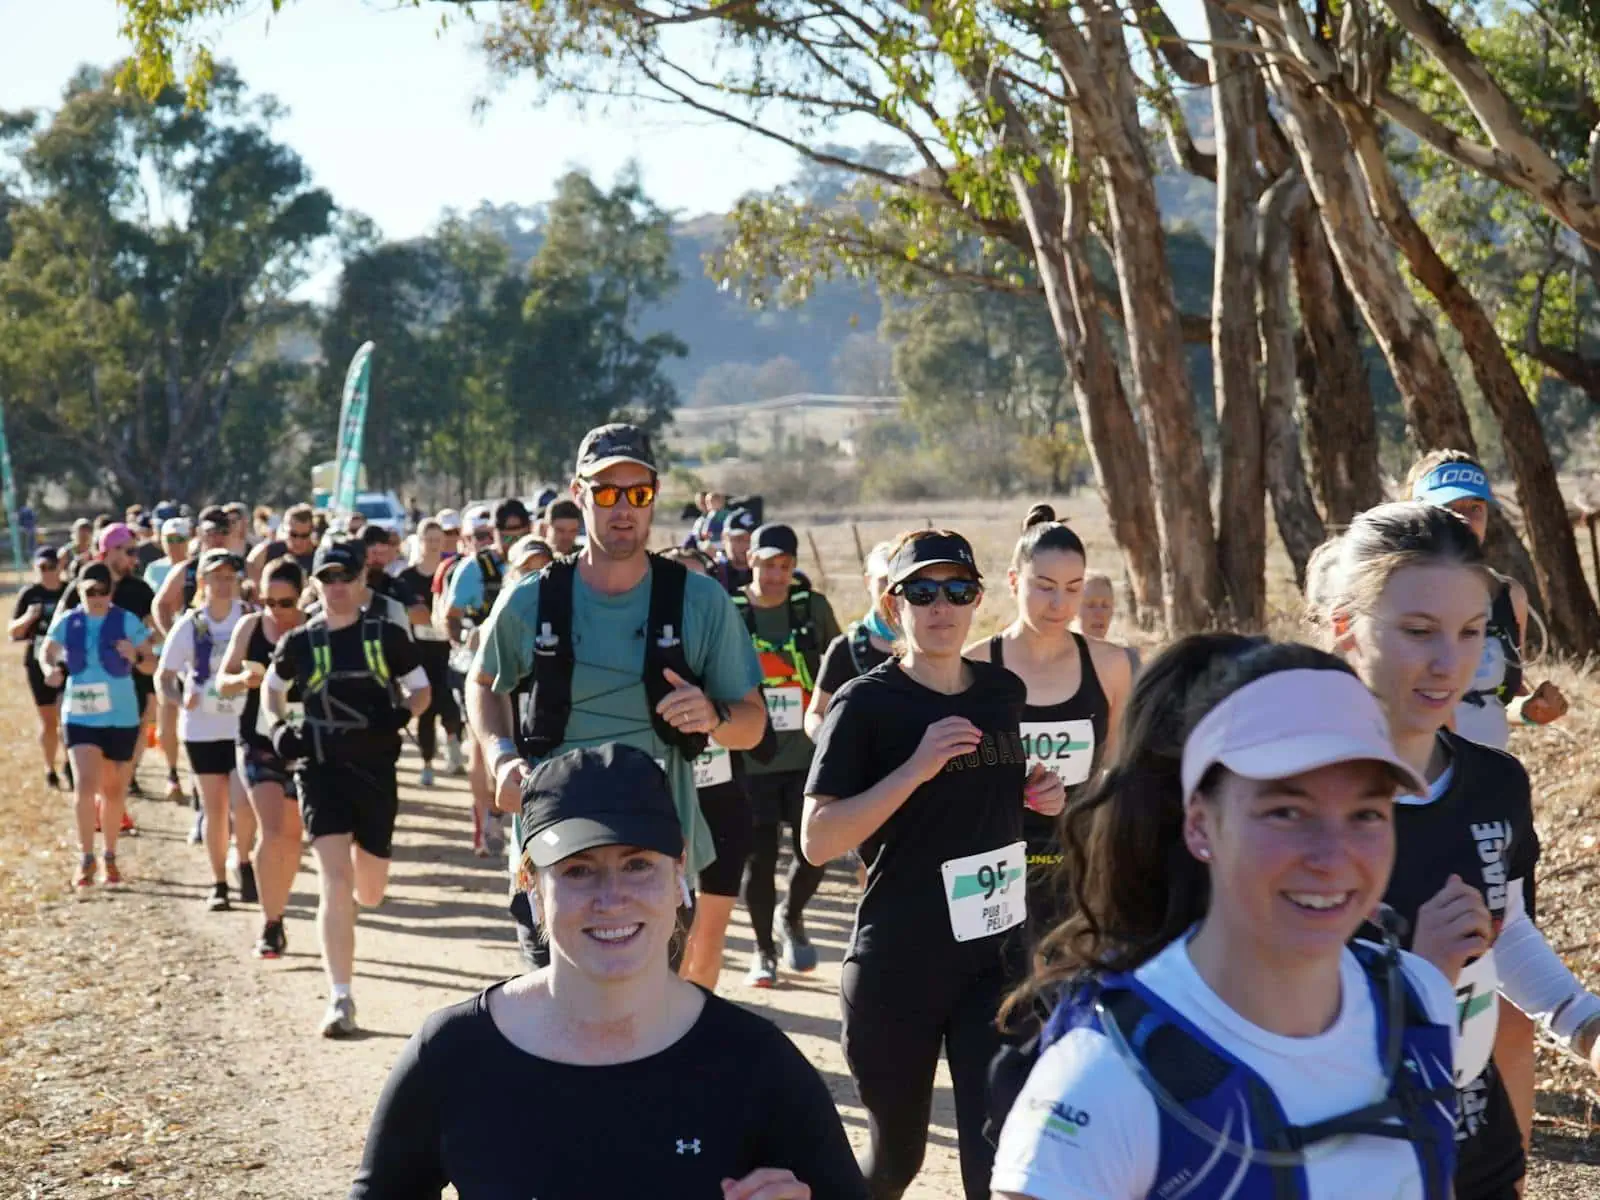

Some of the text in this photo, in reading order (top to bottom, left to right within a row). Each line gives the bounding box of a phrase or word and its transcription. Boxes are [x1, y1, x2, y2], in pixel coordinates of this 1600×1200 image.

[768, 695, 788, 712] 71
[1021, 731, 1071, 760] 102
[977, 860, 1008, 900] 95
[1470, 821, 1506, 911] RACE
